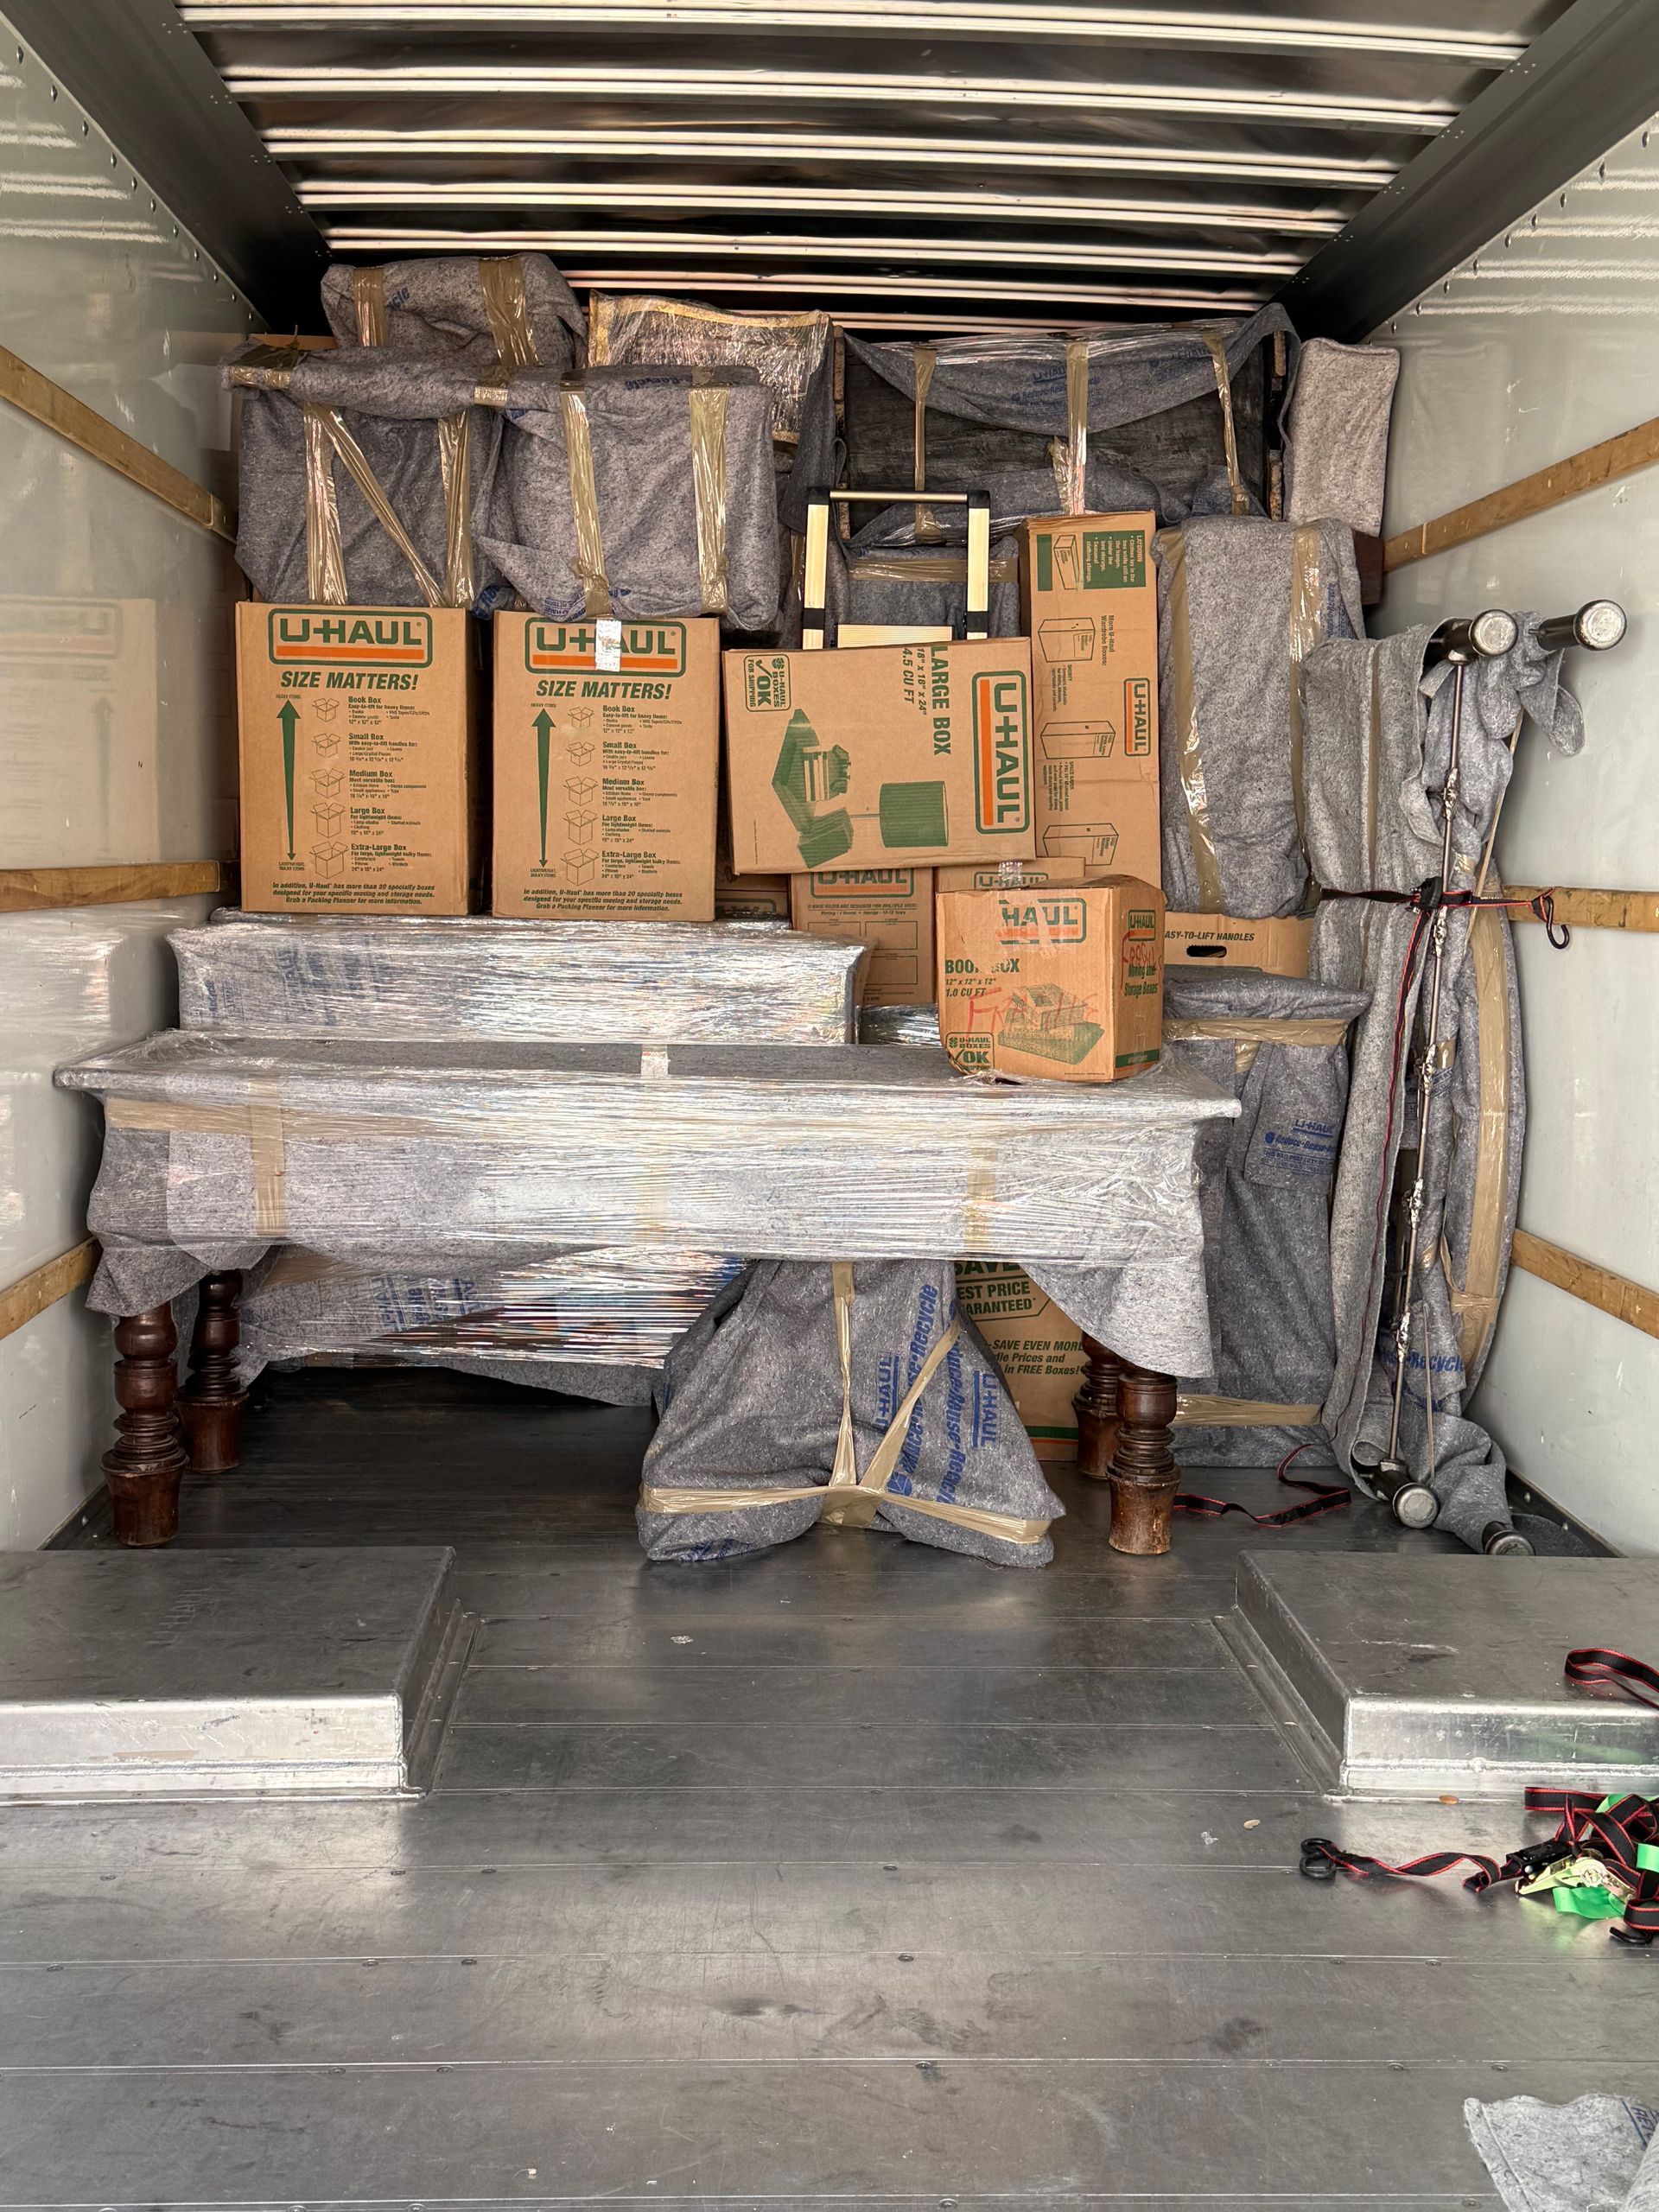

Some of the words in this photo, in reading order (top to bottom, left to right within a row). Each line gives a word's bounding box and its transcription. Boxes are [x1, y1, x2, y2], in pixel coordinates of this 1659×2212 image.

[280, 618, 422, 645] U-HAUL
[902, 648, 912, 665] 4.5
[281, 671, 320, 688] SIZE
[326, 673, 418, 690] MATTERS!
[904, 671, 913, 684] CU
[931, 646, 950, 710] LARGE
[537, 680, 575, 696] SIZE
[582, 682, 671, 699] MATTERS!
[757, 677, 771, 706] OK
[905, 690, 914, 703] FT
[918, 700, 927, 715] 24"
[1135, 684, 1147, 751] U-HAUL
[932, 717, 950, 756] BOX
[995, 683, 1020, 823] U-HAUL
[1130, 915, 1154, 928] U-HAUL
[1164, 931, 1215, 940] ASY-TO-LIFT
[945, 959, 982, 974] BOO
[1128, 965, 1144, 979] Moving
[1125, 983, 1142, 998] Storage
[1143, 982, 1158, 994] Boxes
[963, 1052, 989, 1063] OK
[957, 1286, 982, 1300] EST
[988, 1281, 1030, 1297] PRICE
[965, 1299, 1032, 1314] ARANTEED
[1023, 1341, 1051, 1351] EVEN
[1012, 1353, 1043, 1362] Prices
[1046, 1354, 1065, 1363] and
[1005, 1364, 1014, 1373] in
[1017, 1365, 1042, 1374] FREE
[1046, 1366, 1079, 1375] Boxes!
[982, 1374, 997, 1446] U-HAUL
